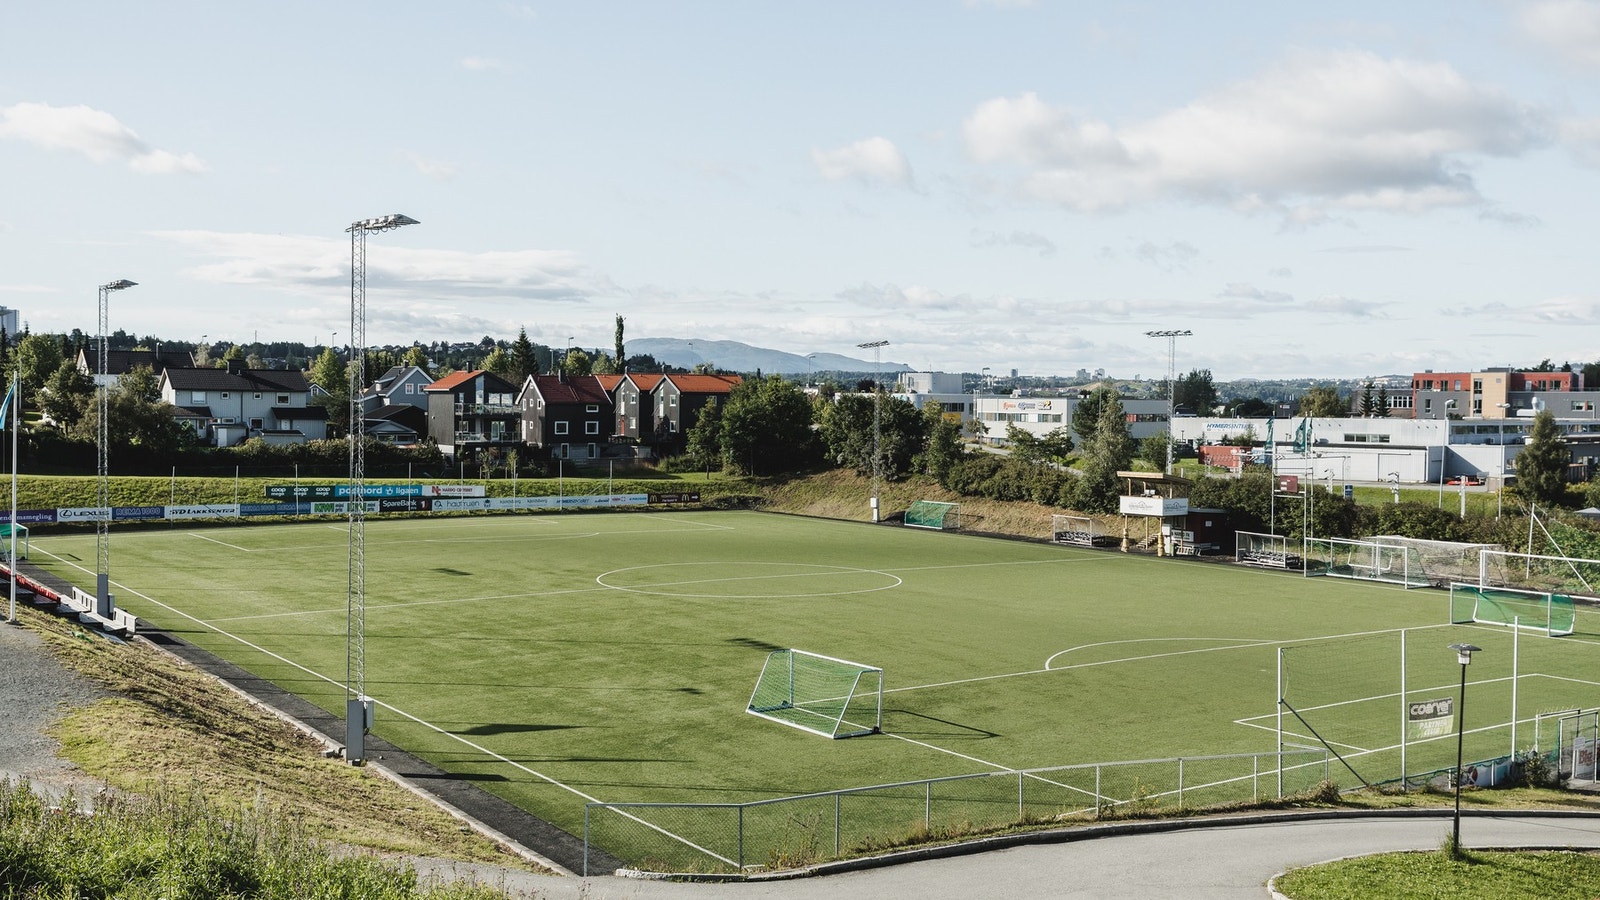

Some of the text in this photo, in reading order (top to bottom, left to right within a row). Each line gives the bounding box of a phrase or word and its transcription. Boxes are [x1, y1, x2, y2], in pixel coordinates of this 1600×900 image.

[116, 507, 161, 516] REMA 1000
[314, 503, 334, 513] KIWI
